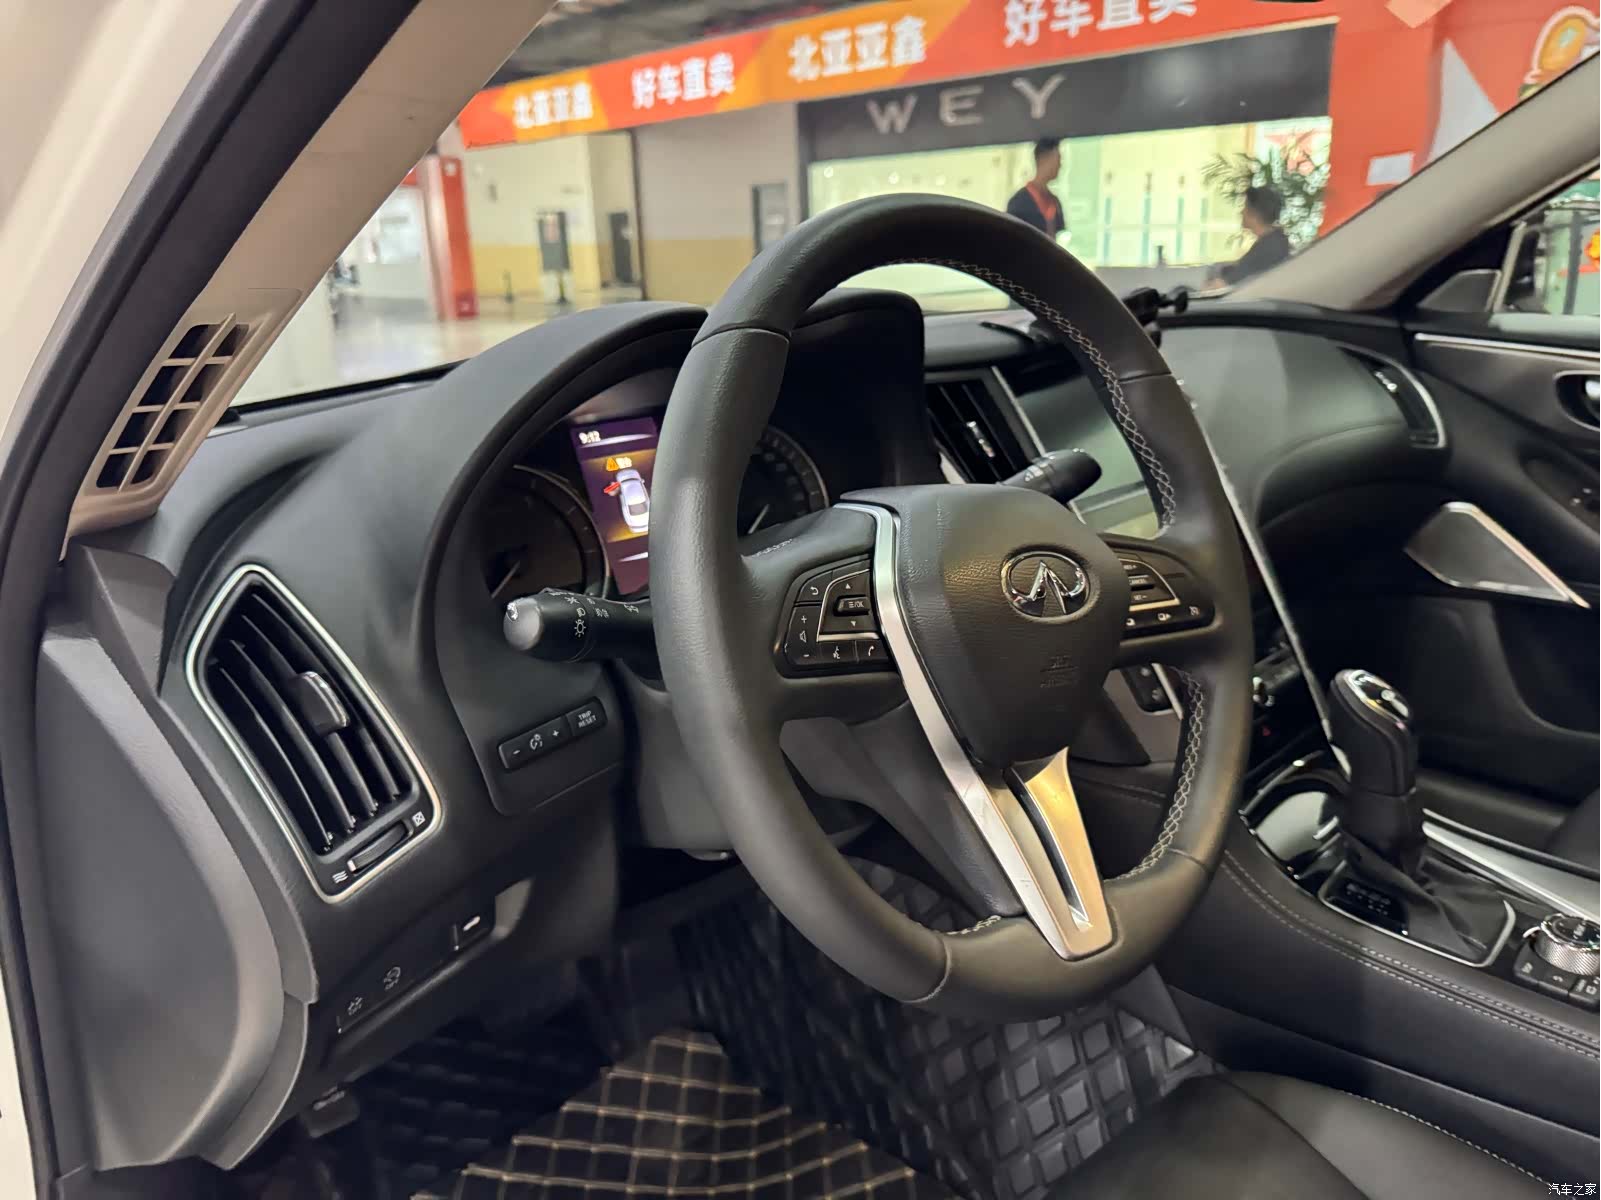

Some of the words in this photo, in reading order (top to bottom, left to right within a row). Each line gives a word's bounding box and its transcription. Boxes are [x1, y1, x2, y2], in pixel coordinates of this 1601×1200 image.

[787, 15, 928, 83] 北亚亚鑫
[631, 52, 735, 109] 好车直卖
[866, 73, 1066, 134] WEY
[578, 710, 592, 721] TRIP
[578, 714, 597, 728] RESET
